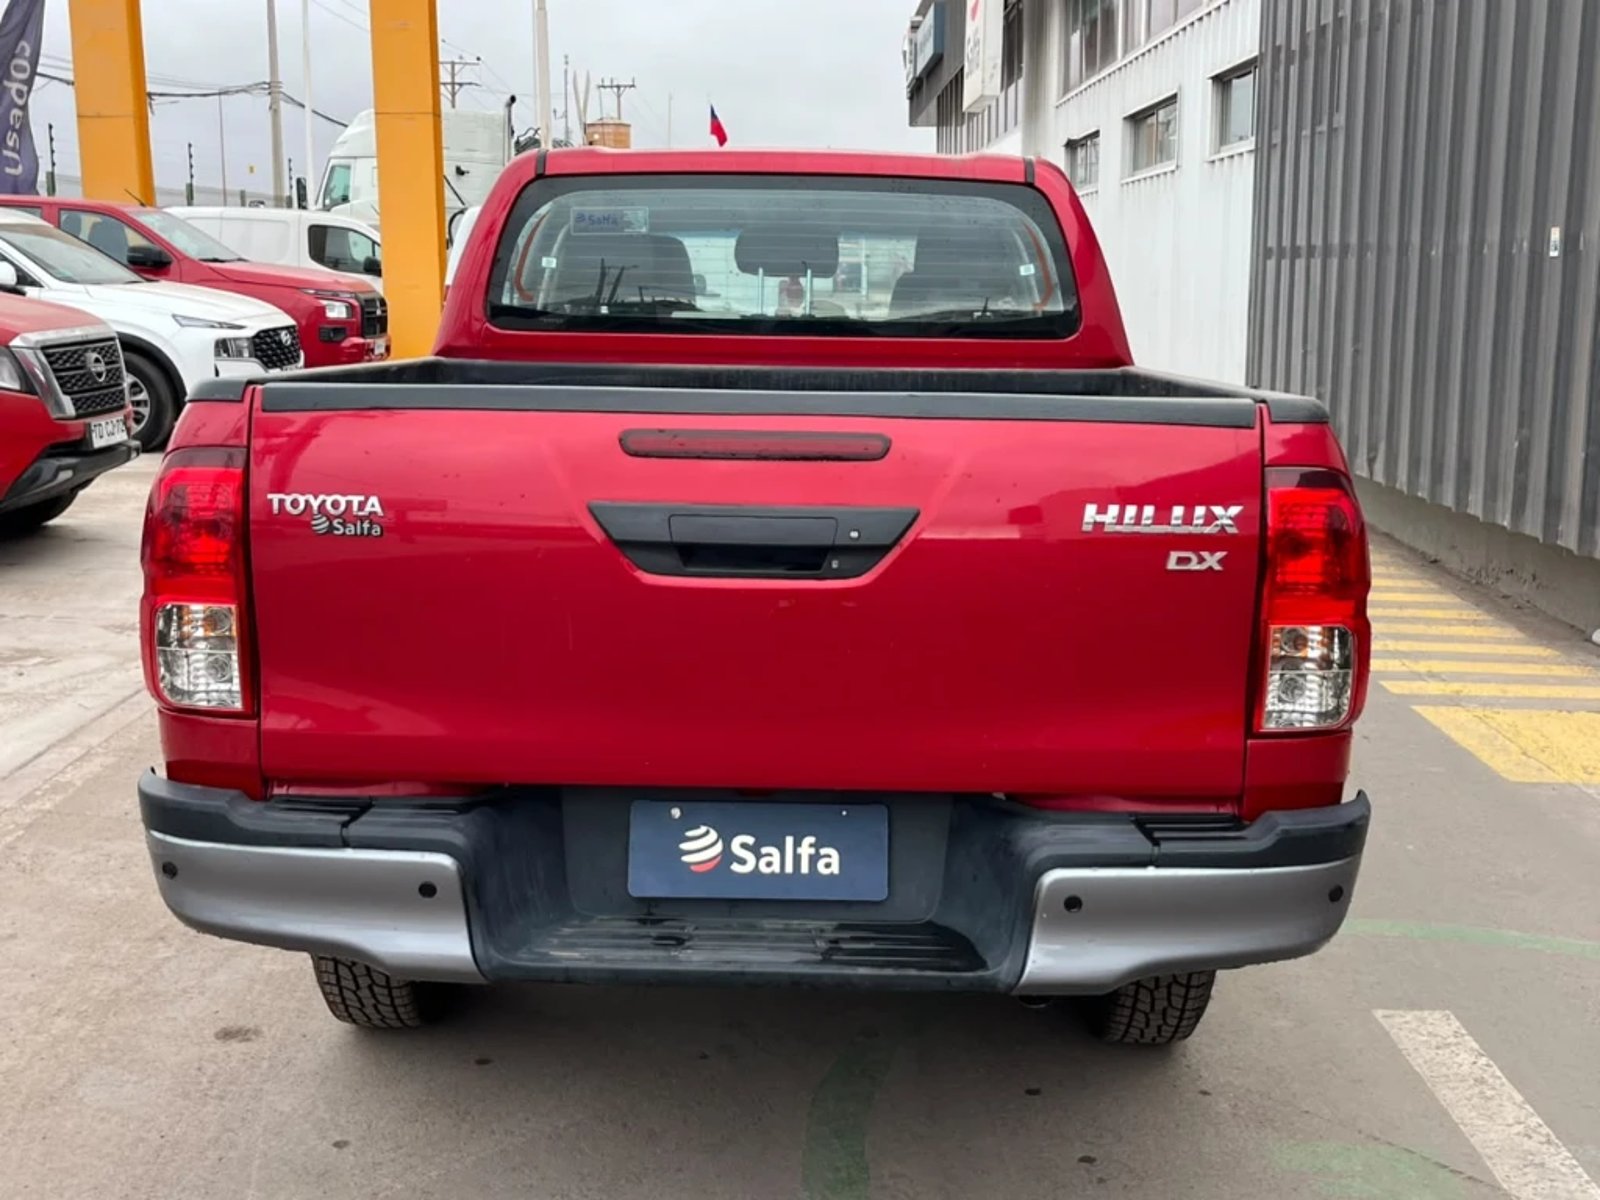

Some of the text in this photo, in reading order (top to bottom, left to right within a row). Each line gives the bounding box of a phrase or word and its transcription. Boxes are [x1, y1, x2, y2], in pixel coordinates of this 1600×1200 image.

[266, 493, 384, 517] TOYOTA
[332, 518, 382, 537] Salfa
[1081, 503, 1244, 535] HILUX
[1166, 550, 1228, 571] DX
[730, 834, 840, 876] Salfa
